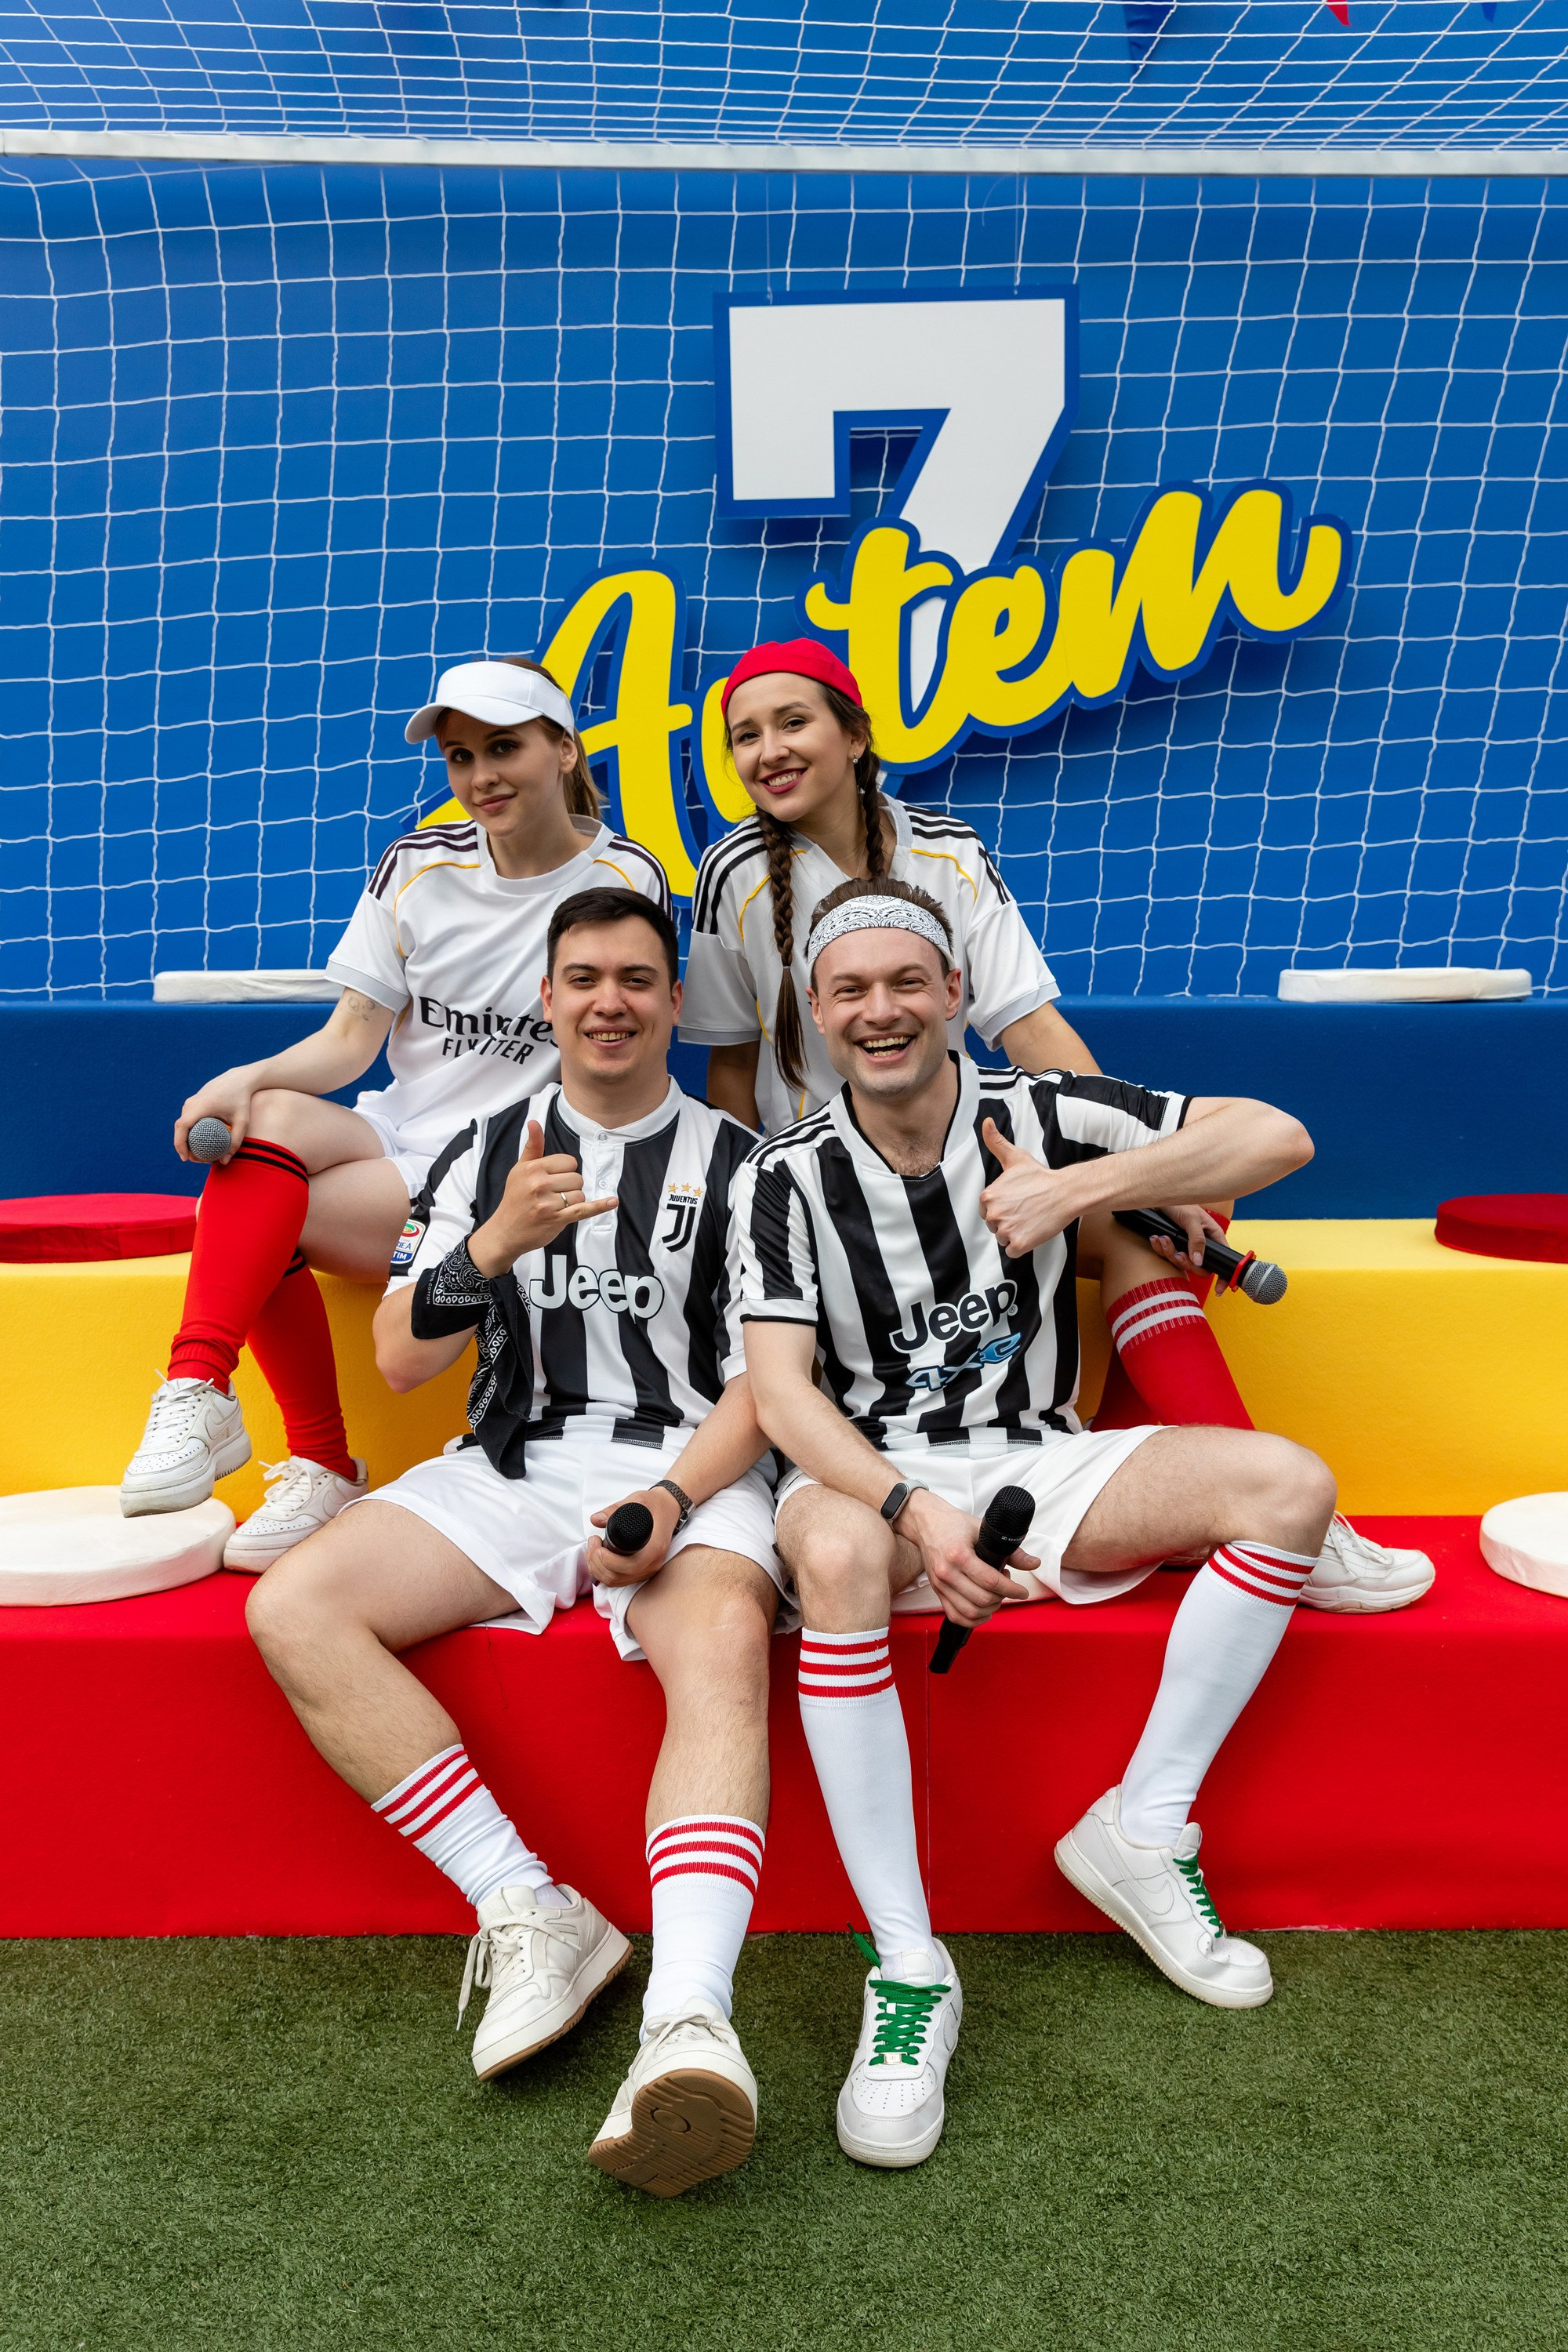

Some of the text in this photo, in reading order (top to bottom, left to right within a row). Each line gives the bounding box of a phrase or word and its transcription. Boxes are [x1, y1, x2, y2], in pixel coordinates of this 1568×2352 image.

[729, 299, 1065, 789] 7
[668, 1193, 699, 1205] JUVENTUS
[393, 1250, 408, 1260] TIM
[529, 1254, 665, 1324] Jeep
[888, 1279, 1018, 1353] Jeep
